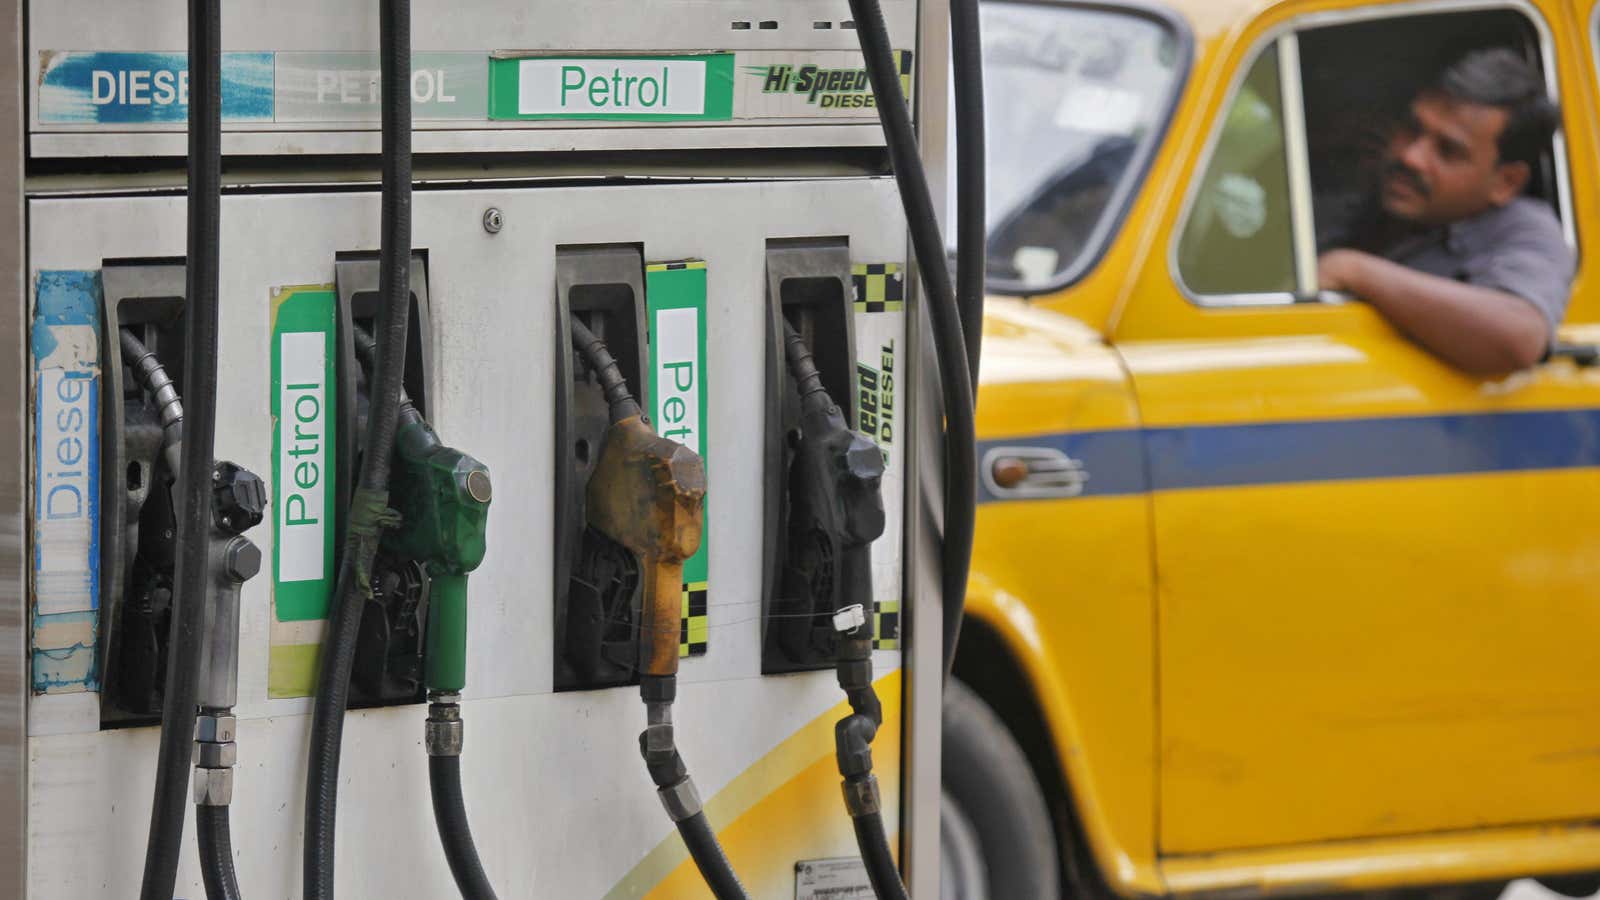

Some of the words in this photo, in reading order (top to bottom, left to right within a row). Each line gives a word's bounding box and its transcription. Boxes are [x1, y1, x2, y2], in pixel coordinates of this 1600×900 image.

[92, 70, 222, 105] DIESE
[560, 65, 668, 107] Petrol
[819, 94, 878, 108] DIESE
[663, 361, 693, 446] Pet
[881, 338, 895, 443] DIESEL
[46, 376, 84, 520] Diese
[286, 383, 320, 526] Petrol
